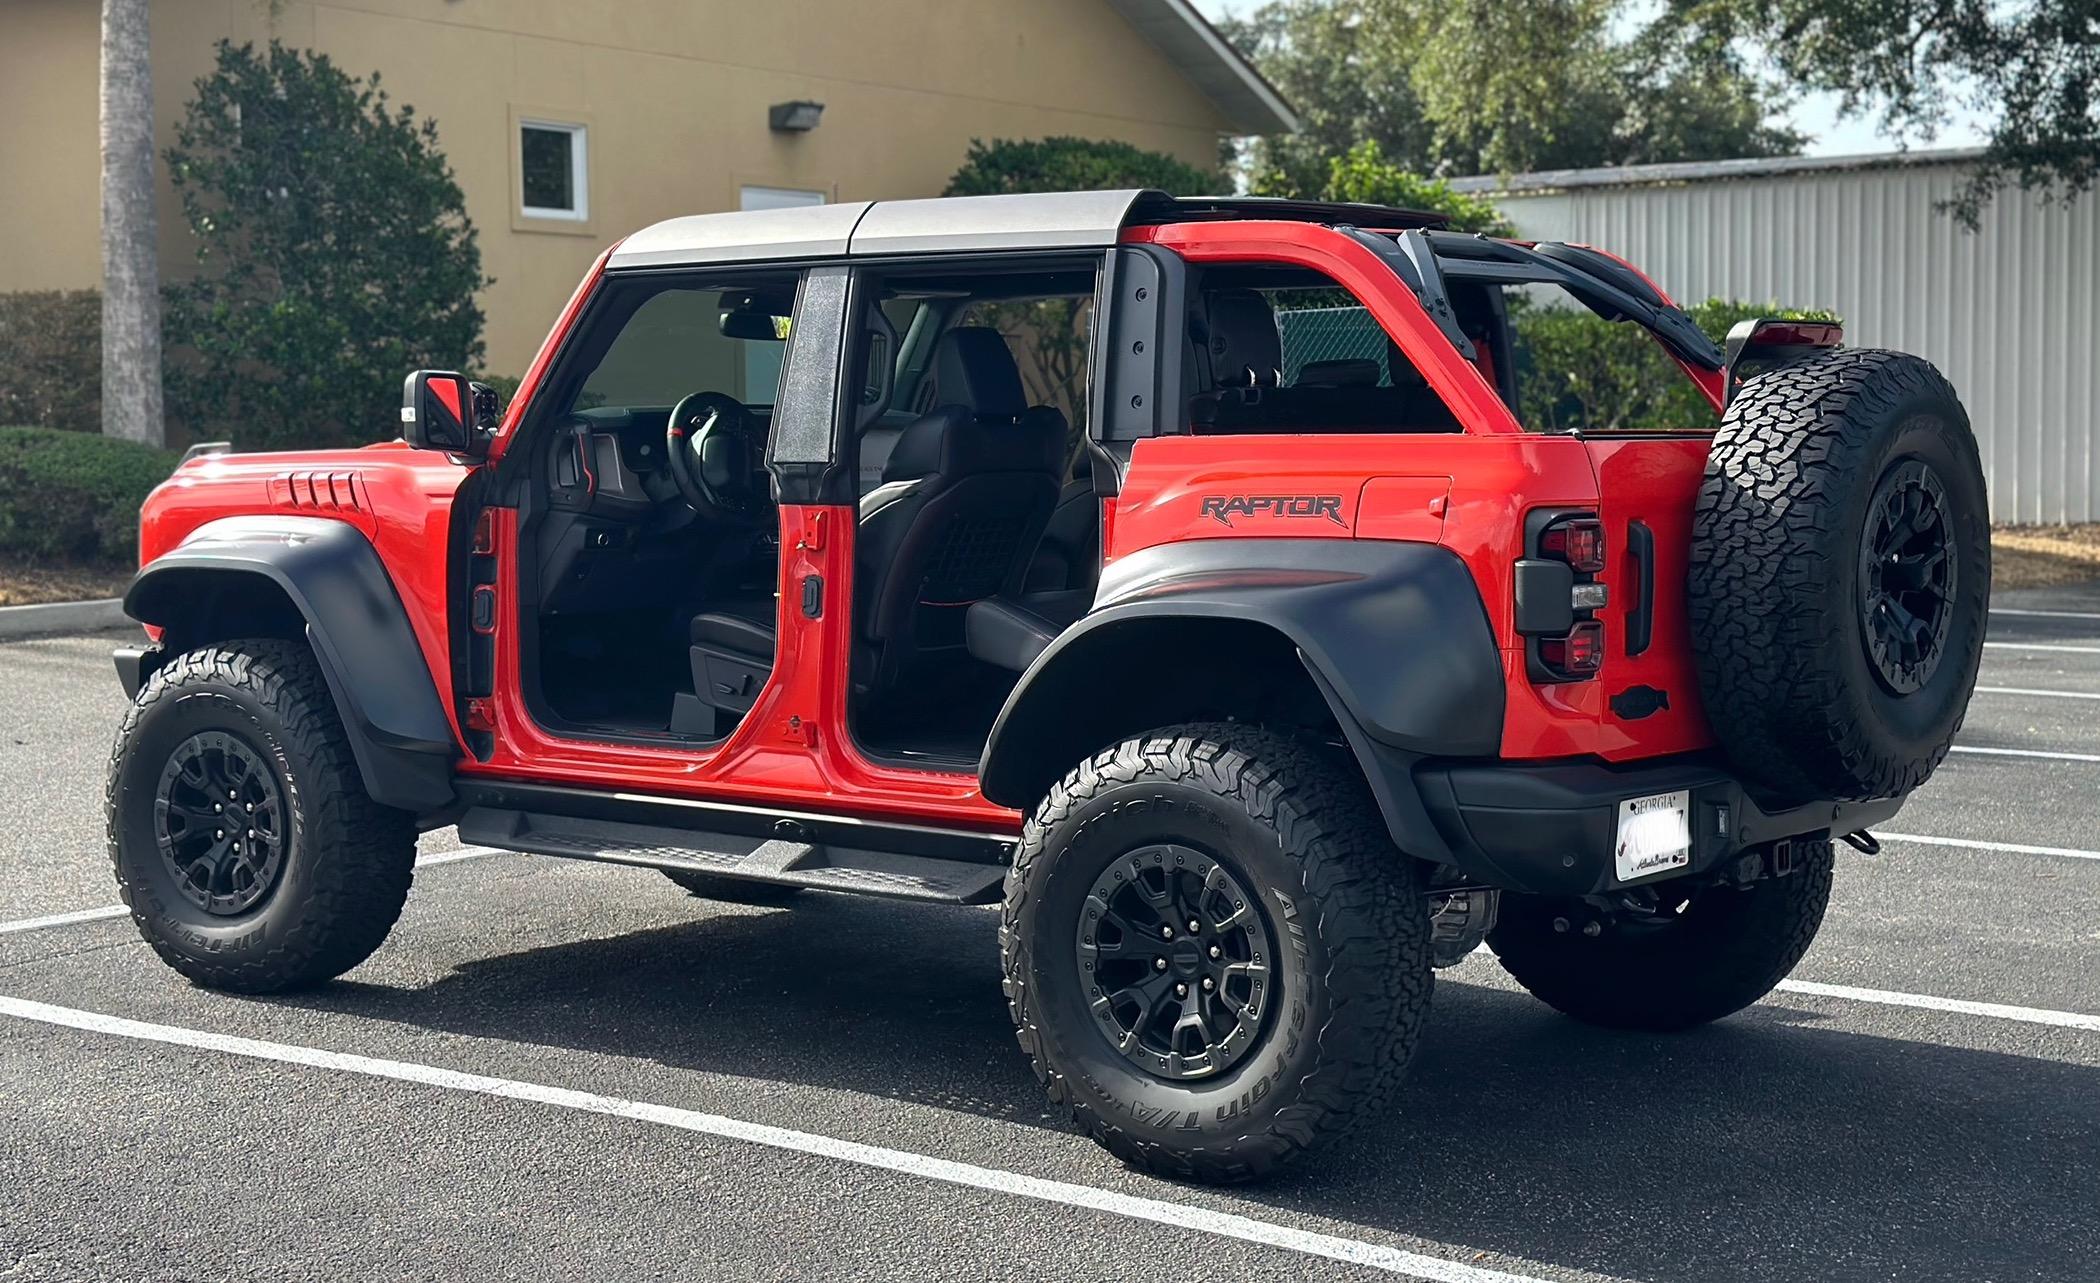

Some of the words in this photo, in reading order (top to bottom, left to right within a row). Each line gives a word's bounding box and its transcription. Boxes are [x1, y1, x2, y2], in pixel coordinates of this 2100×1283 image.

[1199, 494, 1349, 529] RAPTOR
[1633, 795, 1673, 815] GEORGIA
[1129, 1099, 1201, 1131] T/A
